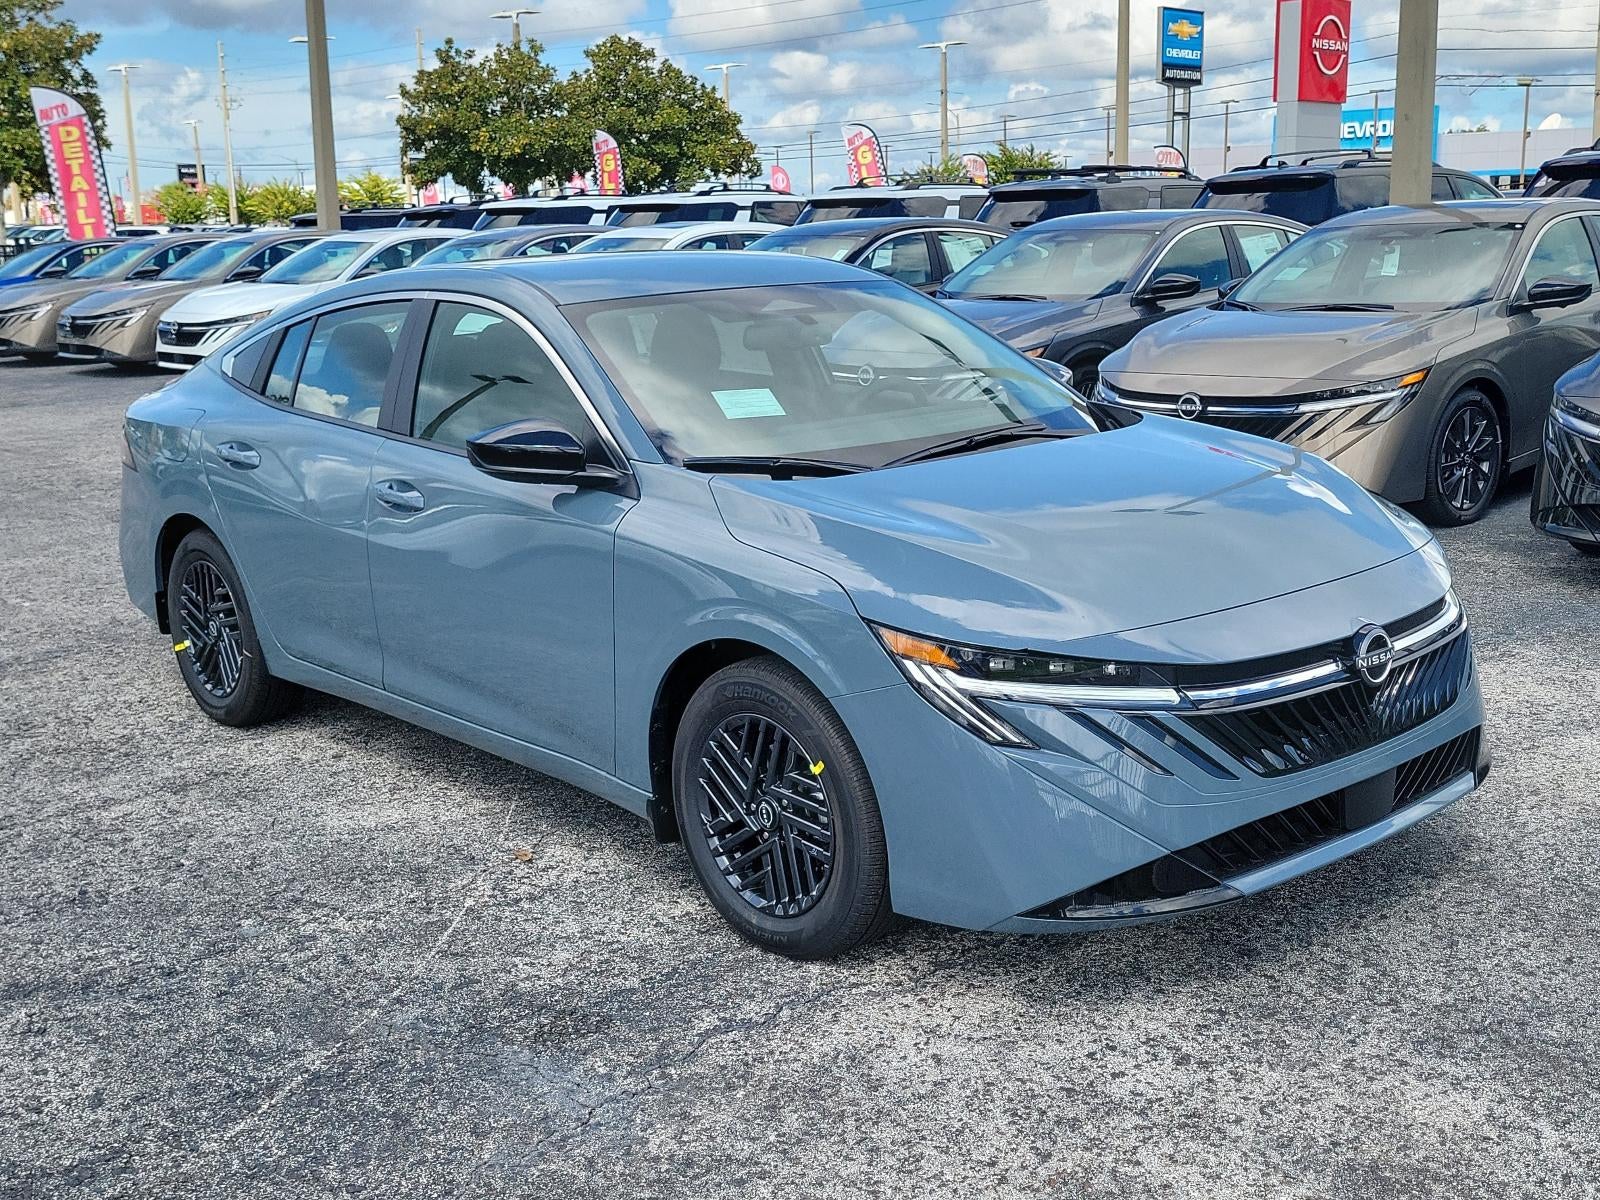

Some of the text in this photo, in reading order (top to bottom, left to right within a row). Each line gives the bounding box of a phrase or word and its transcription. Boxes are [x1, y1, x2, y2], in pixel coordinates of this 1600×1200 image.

[1311, 38, 1349, 51] NISSAN
[1166, 48, 1202, 59] CHEVROLET
[39, 103, 69, 121] AUTO
[602, 153, 617, 194] GL
